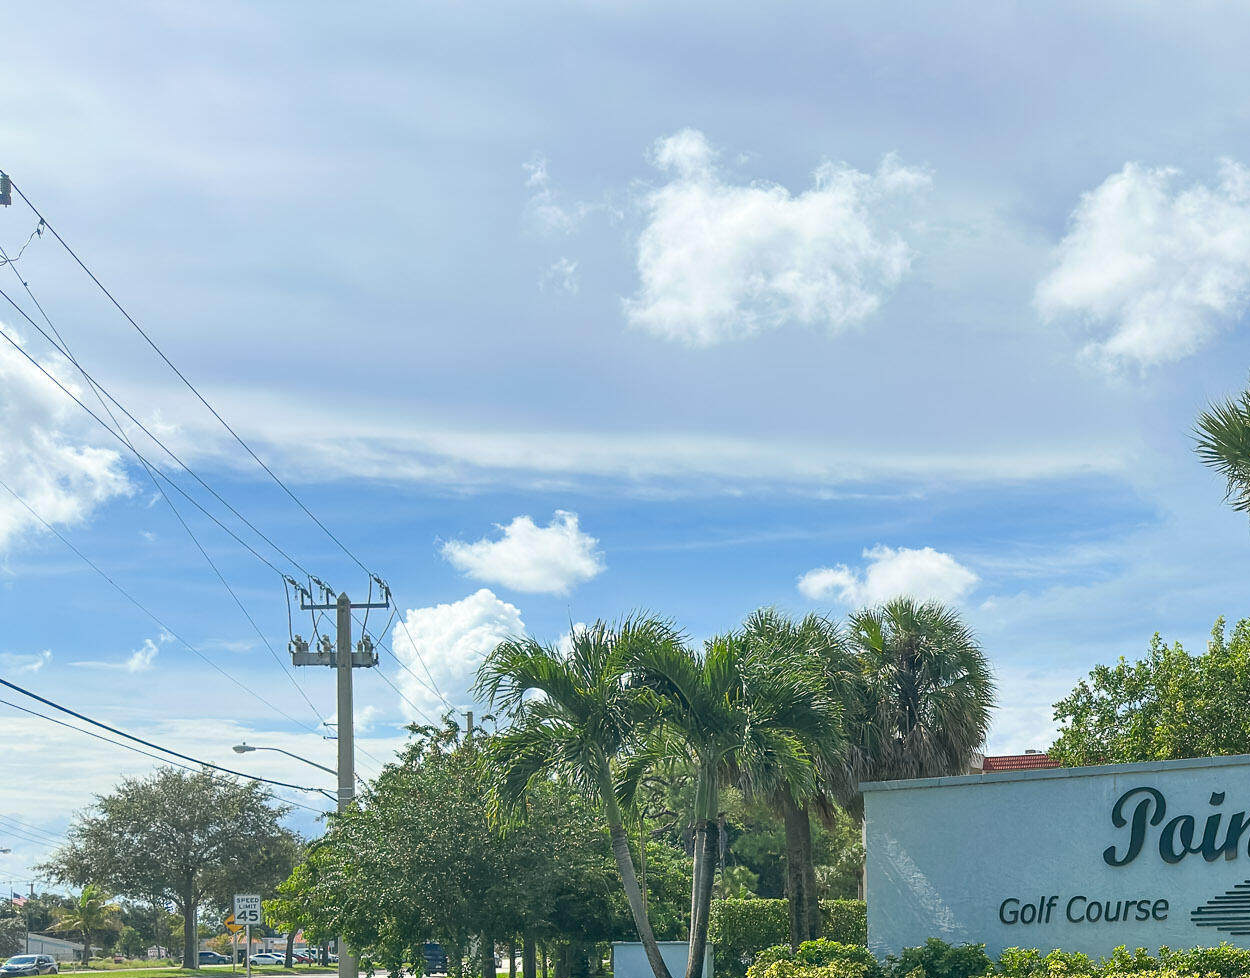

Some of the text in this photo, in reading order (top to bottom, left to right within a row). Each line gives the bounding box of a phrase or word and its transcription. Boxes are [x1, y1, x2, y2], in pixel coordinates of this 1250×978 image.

[236, 910, 259, 921] 45
[997, 894, 1170, 926] Golf Course
